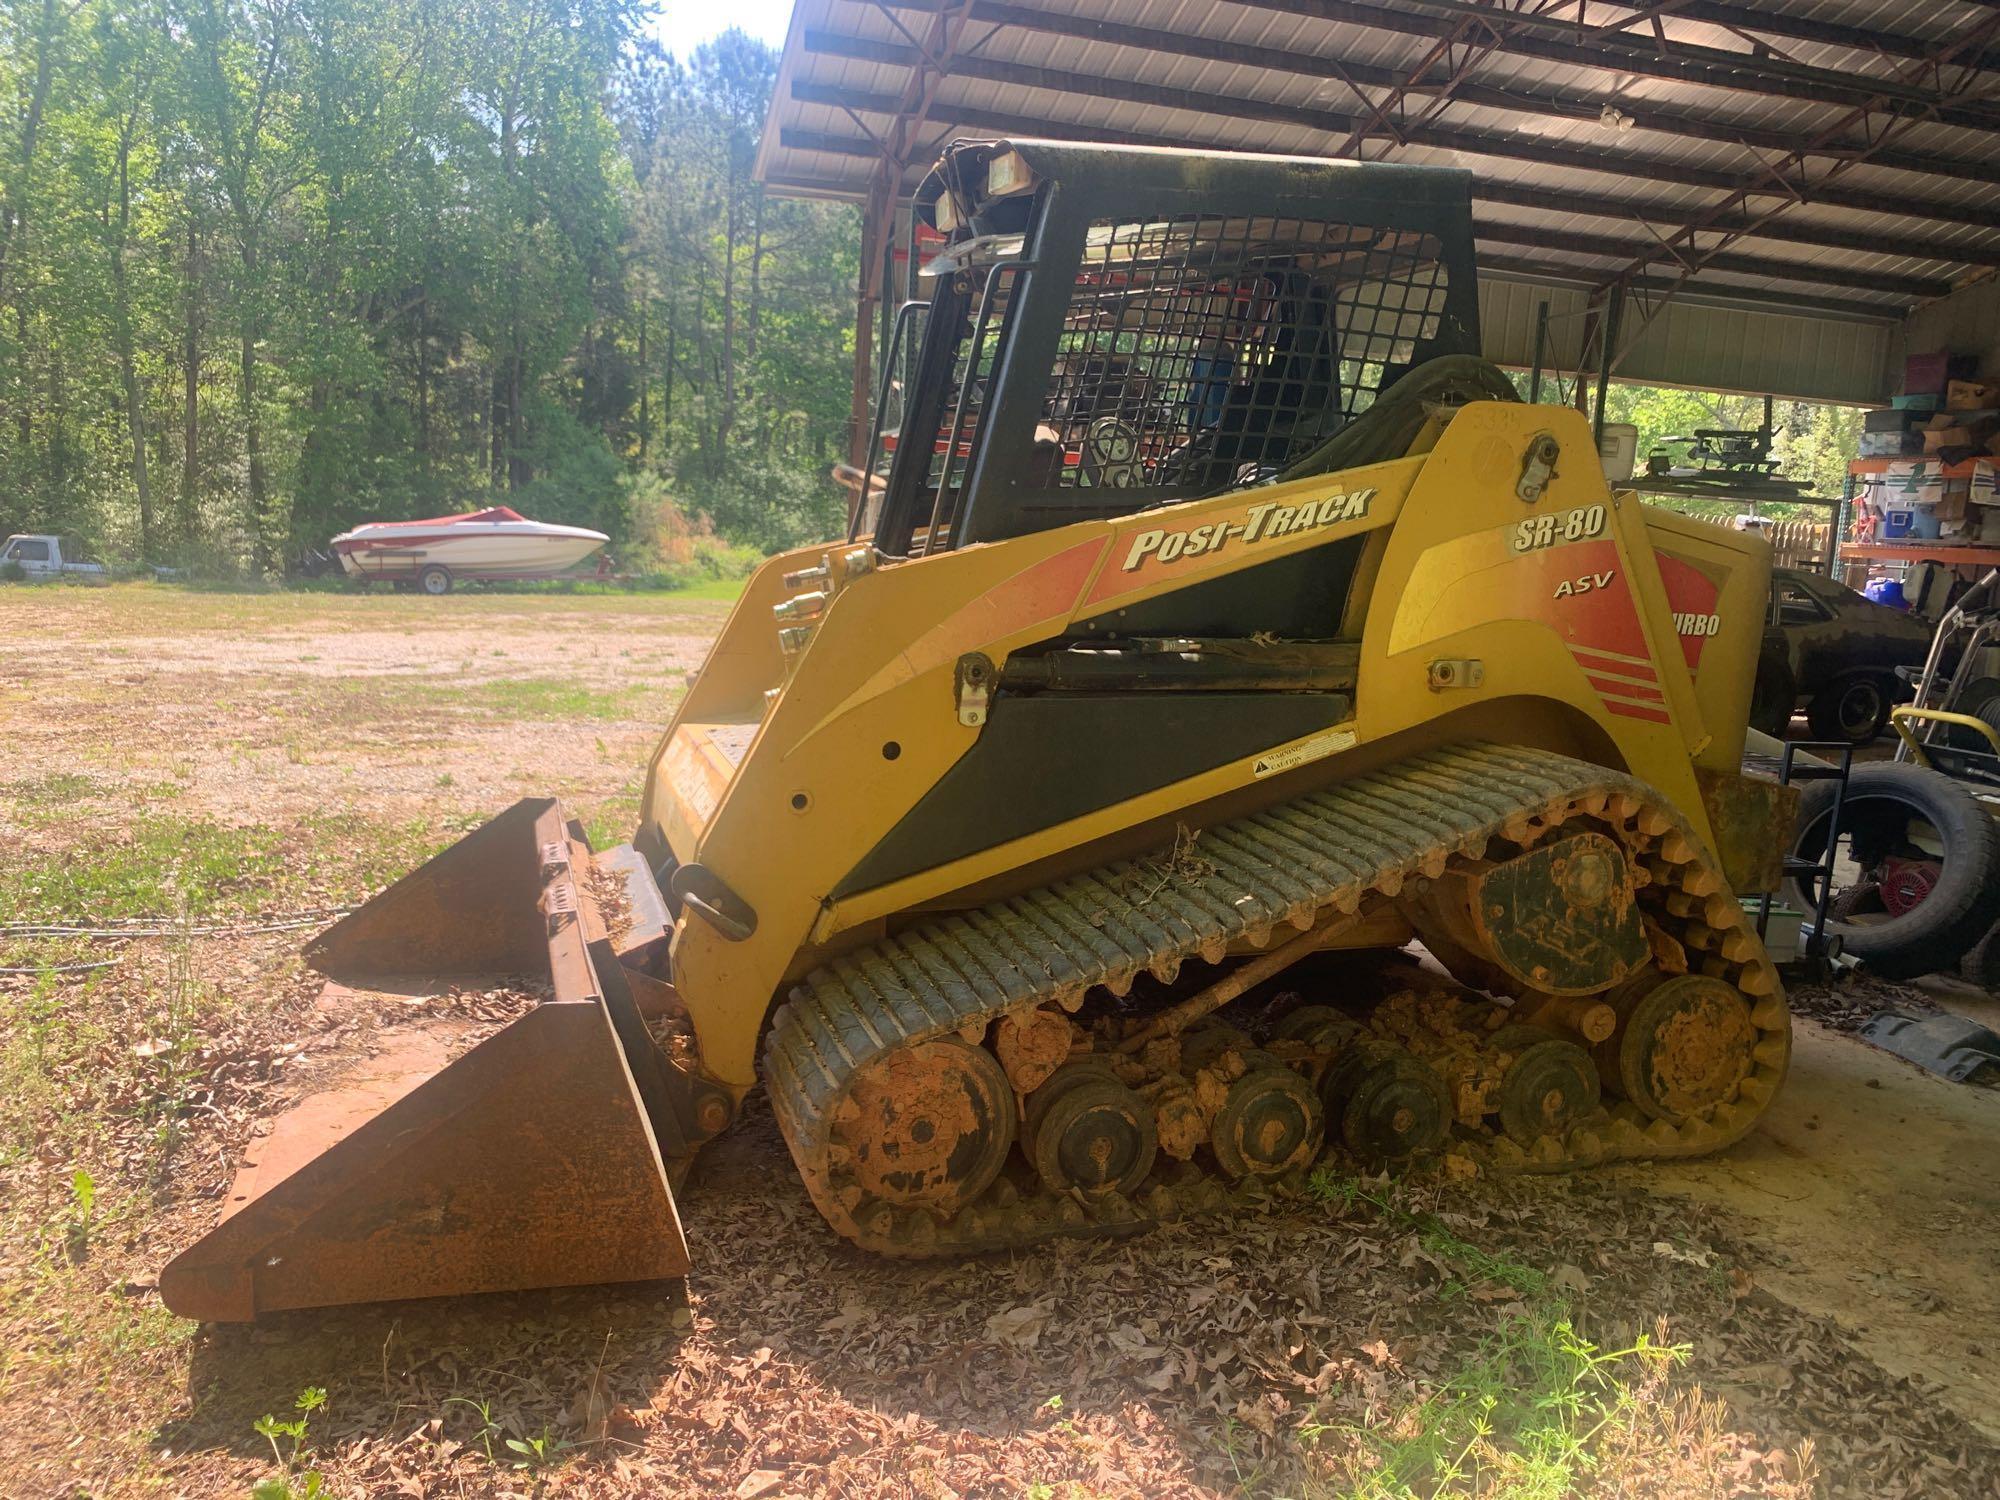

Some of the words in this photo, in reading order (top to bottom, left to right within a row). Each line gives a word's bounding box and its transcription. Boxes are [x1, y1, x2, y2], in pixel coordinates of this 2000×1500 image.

[1514, 504, 1607, 552] SR-80
[1553, 570, 1616, 600] ASV
[1672, 612, 1720, 637] URBO
[1268, 746, 1302, 761] WARNING
[1270, 756, 1303, 770] CAUTION
